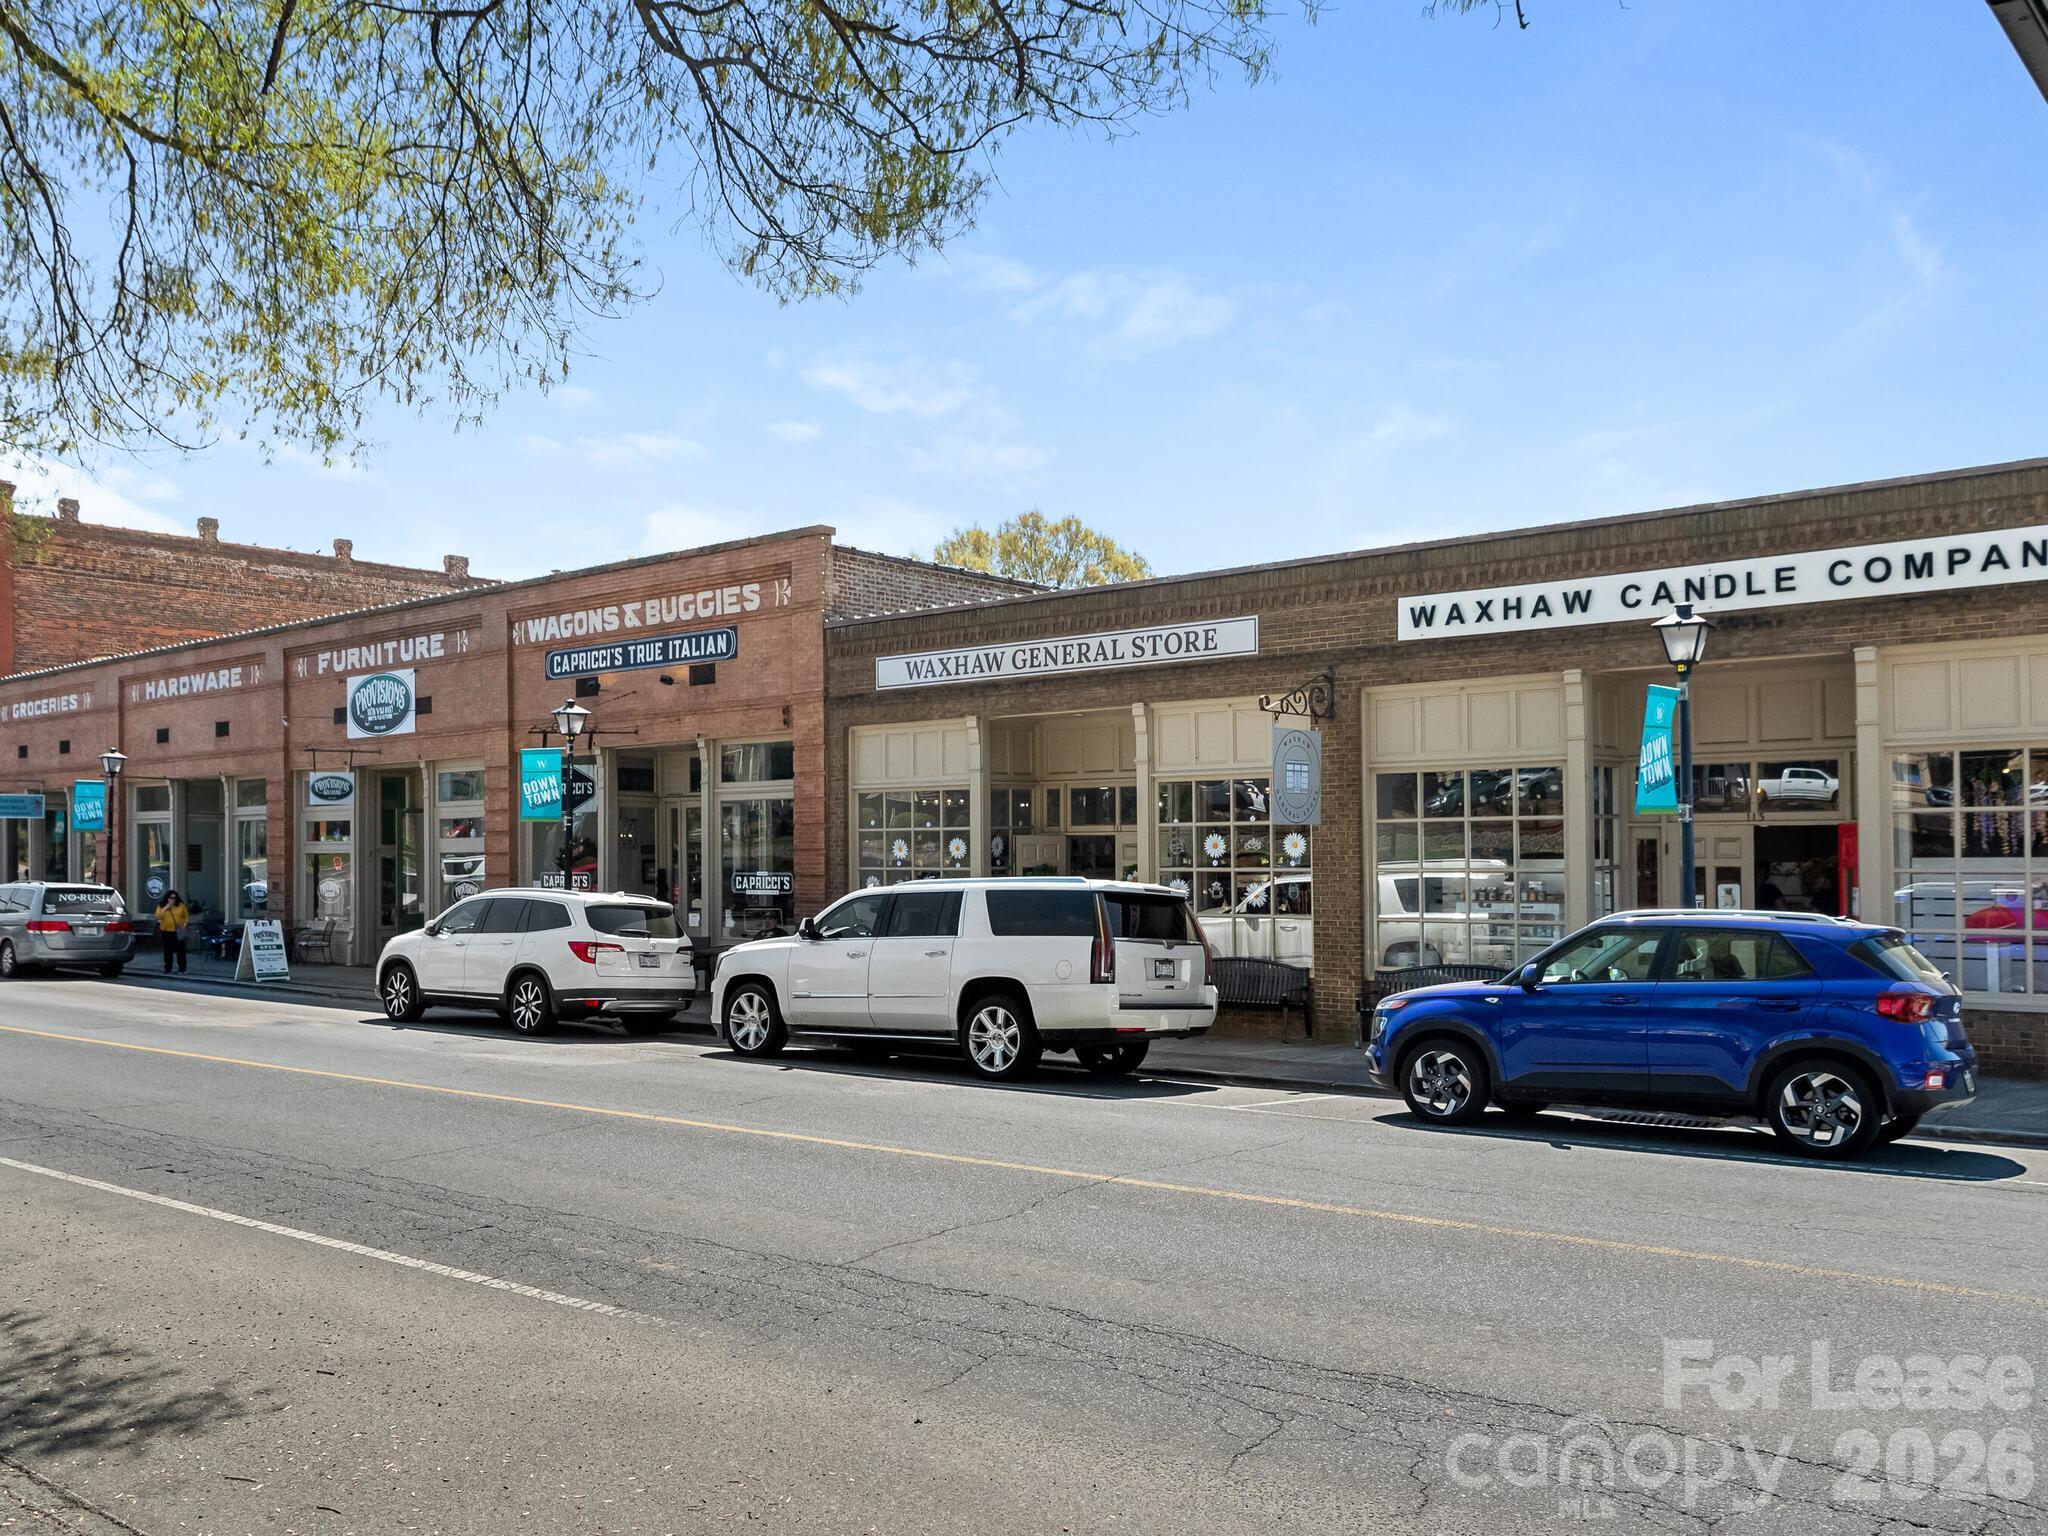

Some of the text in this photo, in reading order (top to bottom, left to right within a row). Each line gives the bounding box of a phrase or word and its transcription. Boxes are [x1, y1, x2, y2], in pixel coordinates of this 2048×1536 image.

[1409, 538, 2048, 630] WAXHAW CANDLE COMPAN
[527, 583, 761, 643] WAGONS & BUGGIES
[318, 633, 445, 675] FURNITURE
[553, 633, 727, 674] CAPRICCI'S TRUE ITALIAN
[905, 627, 1219, 681] WAXHAW GENERAL STORE
[146, 667, 242, 699] HARDWARE
[355, 679, 406, 716] PROVISIONS
[12, 695, 78, 718] GROCERIES
[1640, 734, 1668, 767] DOWN
[522, 775, 558, 796] DOWN
[1640, 756, 1672, 785] TOWN
[73, 800, 101, 813] DOWN
[525, 787, 560, 808] TOWN
[77, 809, 103, 821] TOWN
[735, 876, 790, 889] CAPRICCI'S
